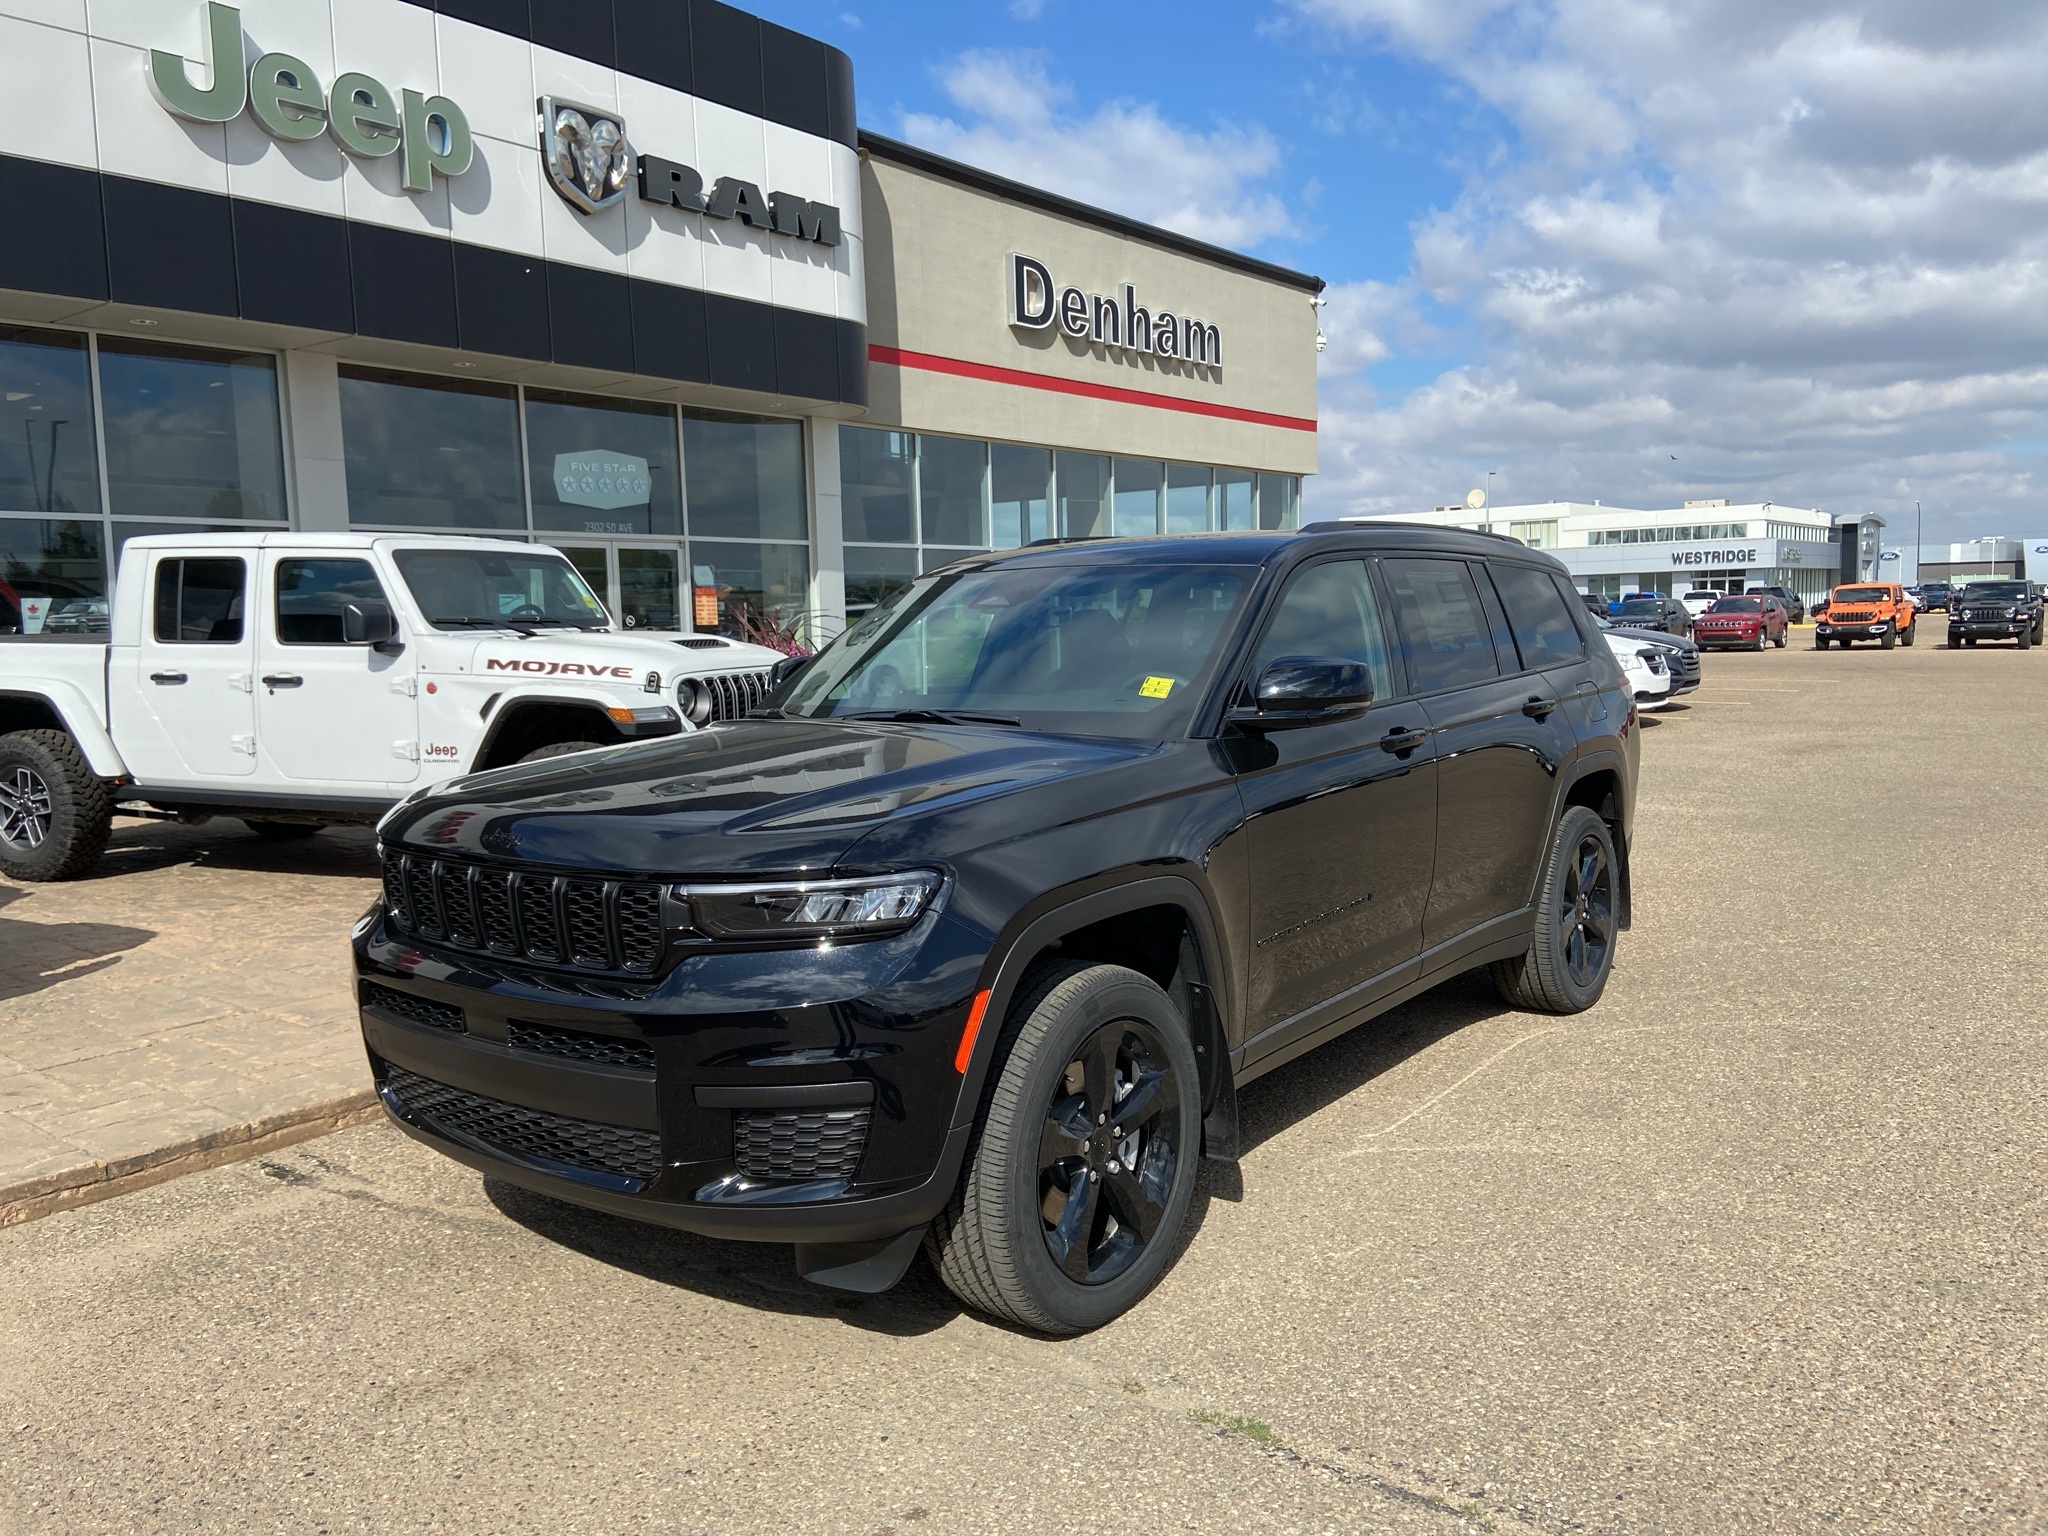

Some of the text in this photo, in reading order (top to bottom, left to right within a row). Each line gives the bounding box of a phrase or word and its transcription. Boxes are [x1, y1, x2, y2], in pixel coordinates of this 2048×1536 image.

[144, 0, 475, 193] Jeep
[637, 154, 841, 247] RAM
[1007, 252, 1223, 367] Denham
[570, 461, 636, 473] FIVE STAR
[584, 521, 634, 534] 2302 50 AVE
[1671, 549, 1757, 566] WESTRIDGE
[486, 658, 634, 679] MOJAVE
[425, 742, 458, 758] Jeep
